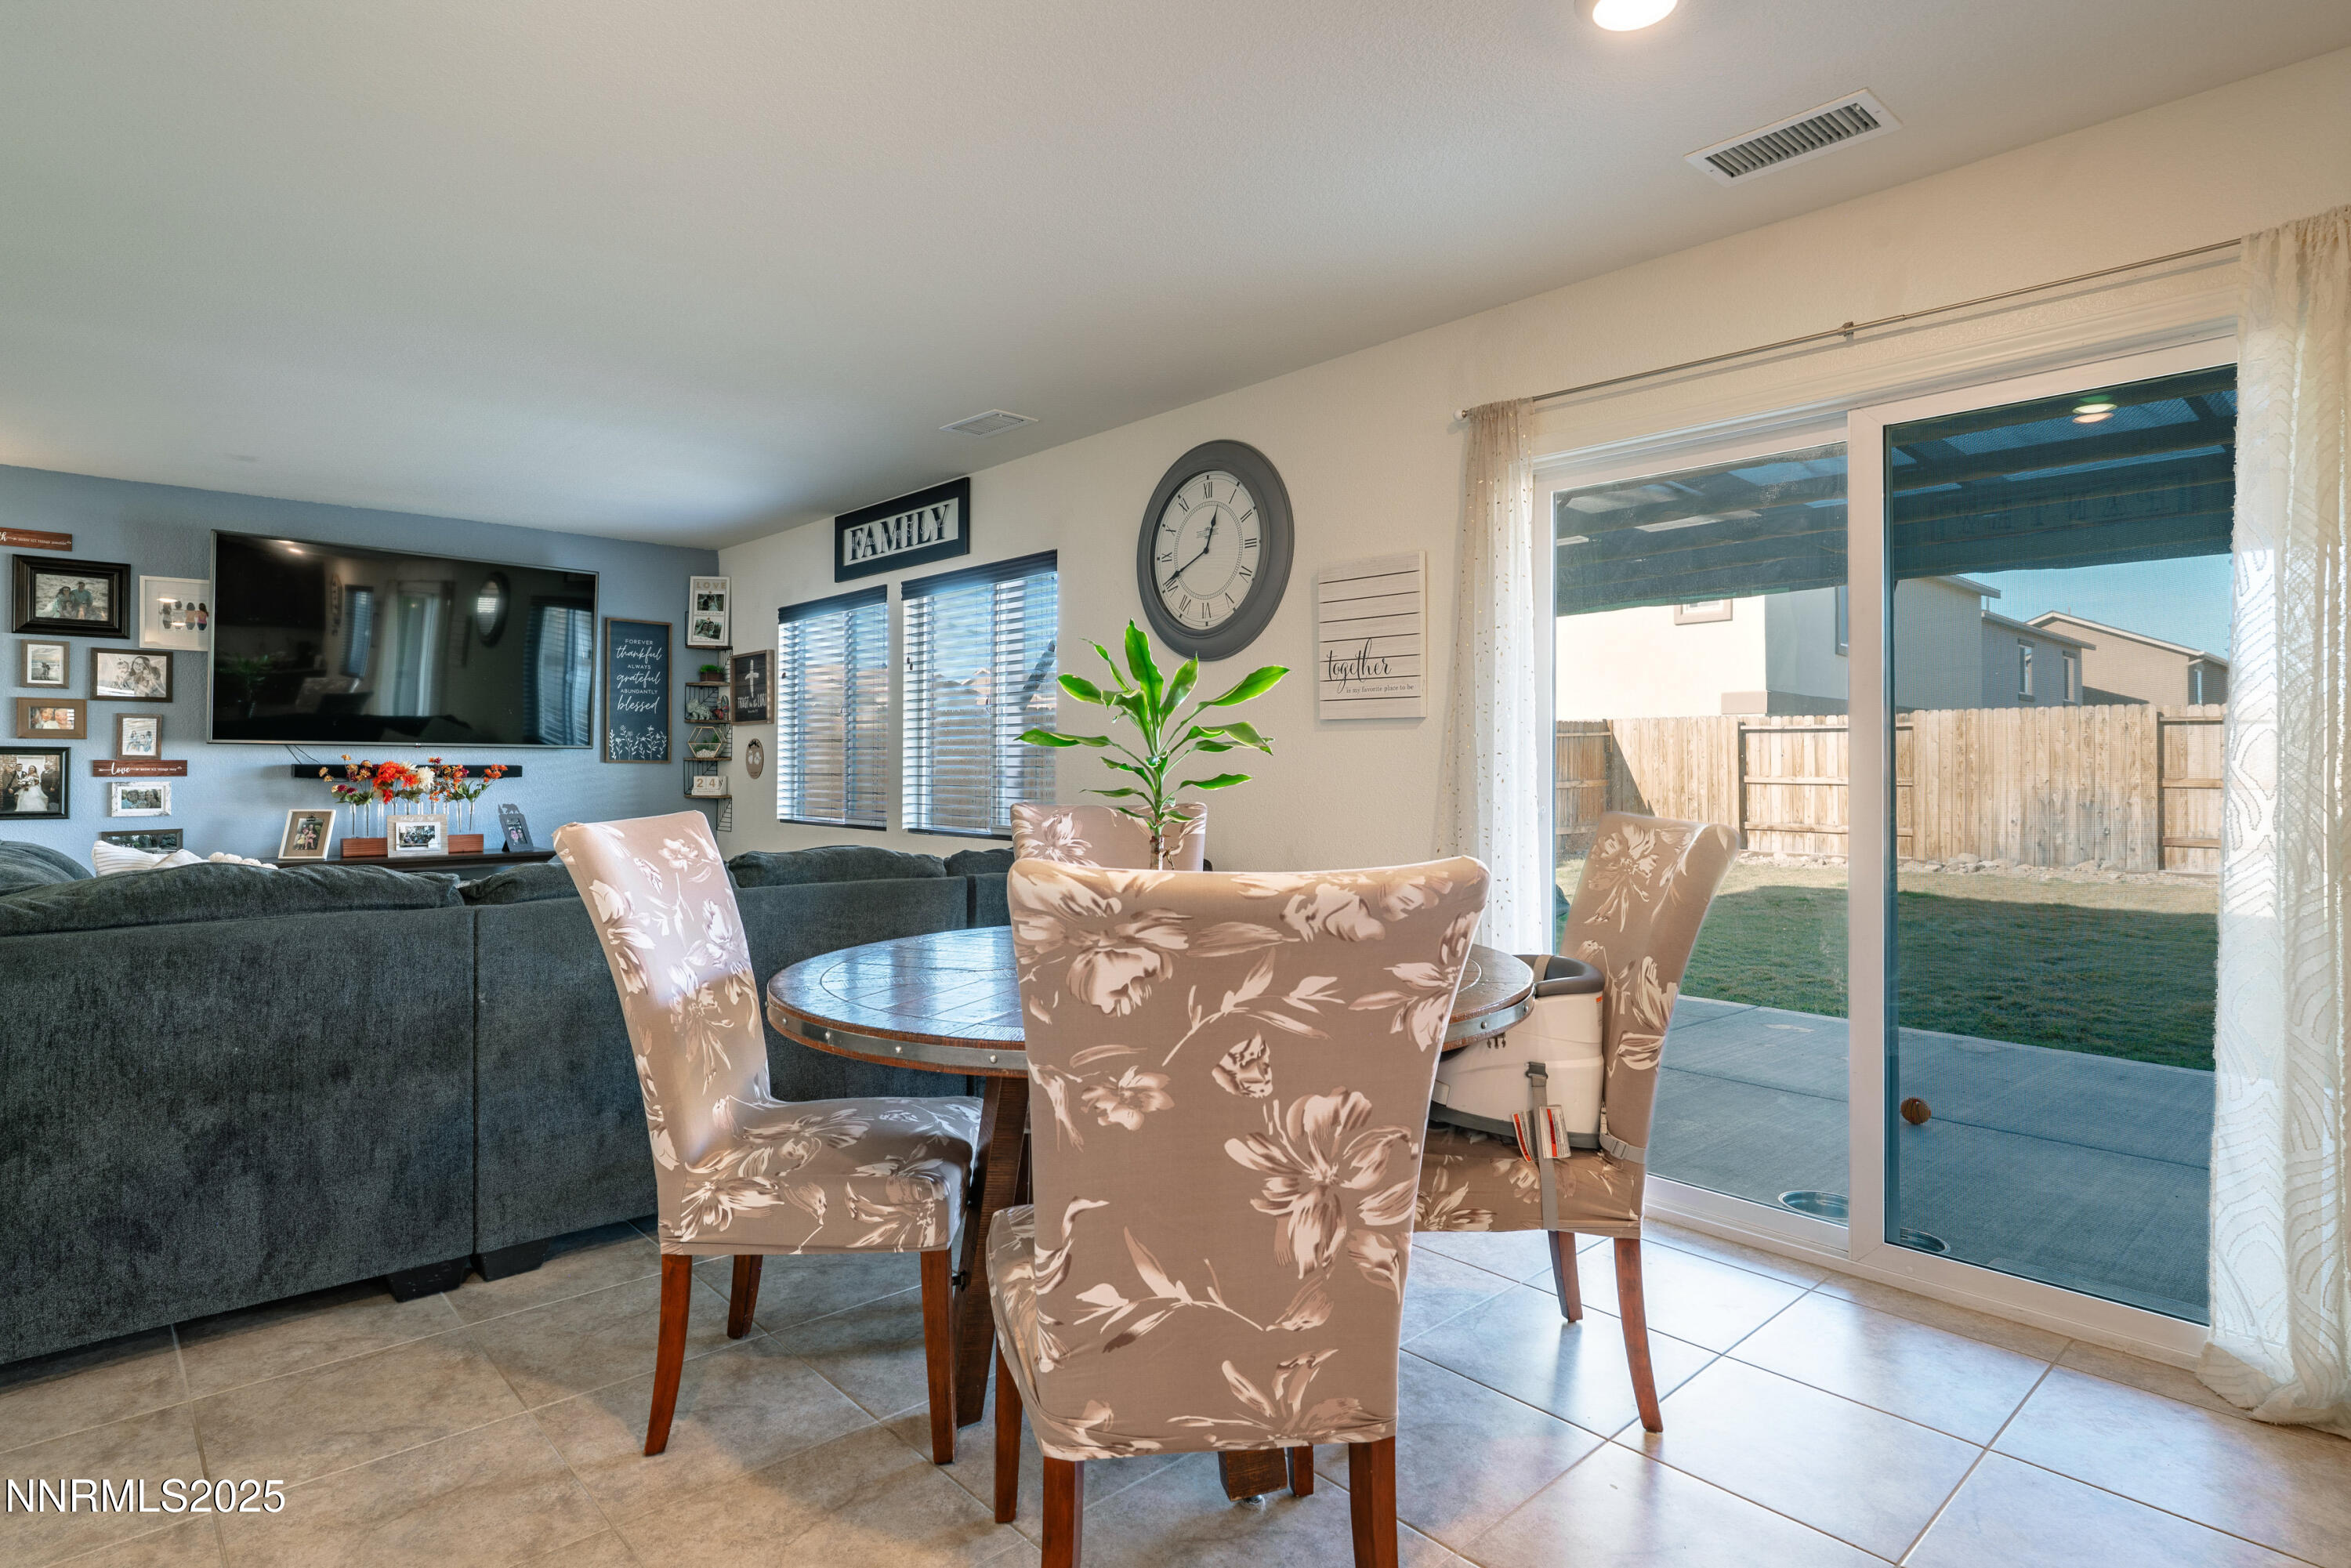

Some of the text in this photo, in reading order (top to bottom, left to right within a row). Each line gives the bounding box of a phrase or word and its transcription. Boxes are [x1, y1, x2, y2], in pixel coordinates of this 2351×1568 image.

[1203, 481, 1212, 499] XII
[1179, 498, 1190, 515] XI
[849, 504, 949, 560] FAMILY
[1165, 525, 1176, 537] X
[1161, 552, 1172, 563] IX
[1179, 595, 1191, 614] VII
[1225, 592, 1234, 608] V
[1202, 602, 1211, 619] VI
[616, 644, 662, 664] thankful
[1326, 637, 1392, 693] together
[617, 670, 661, 689] grateful
[617, 694, 660, 714] blessed
